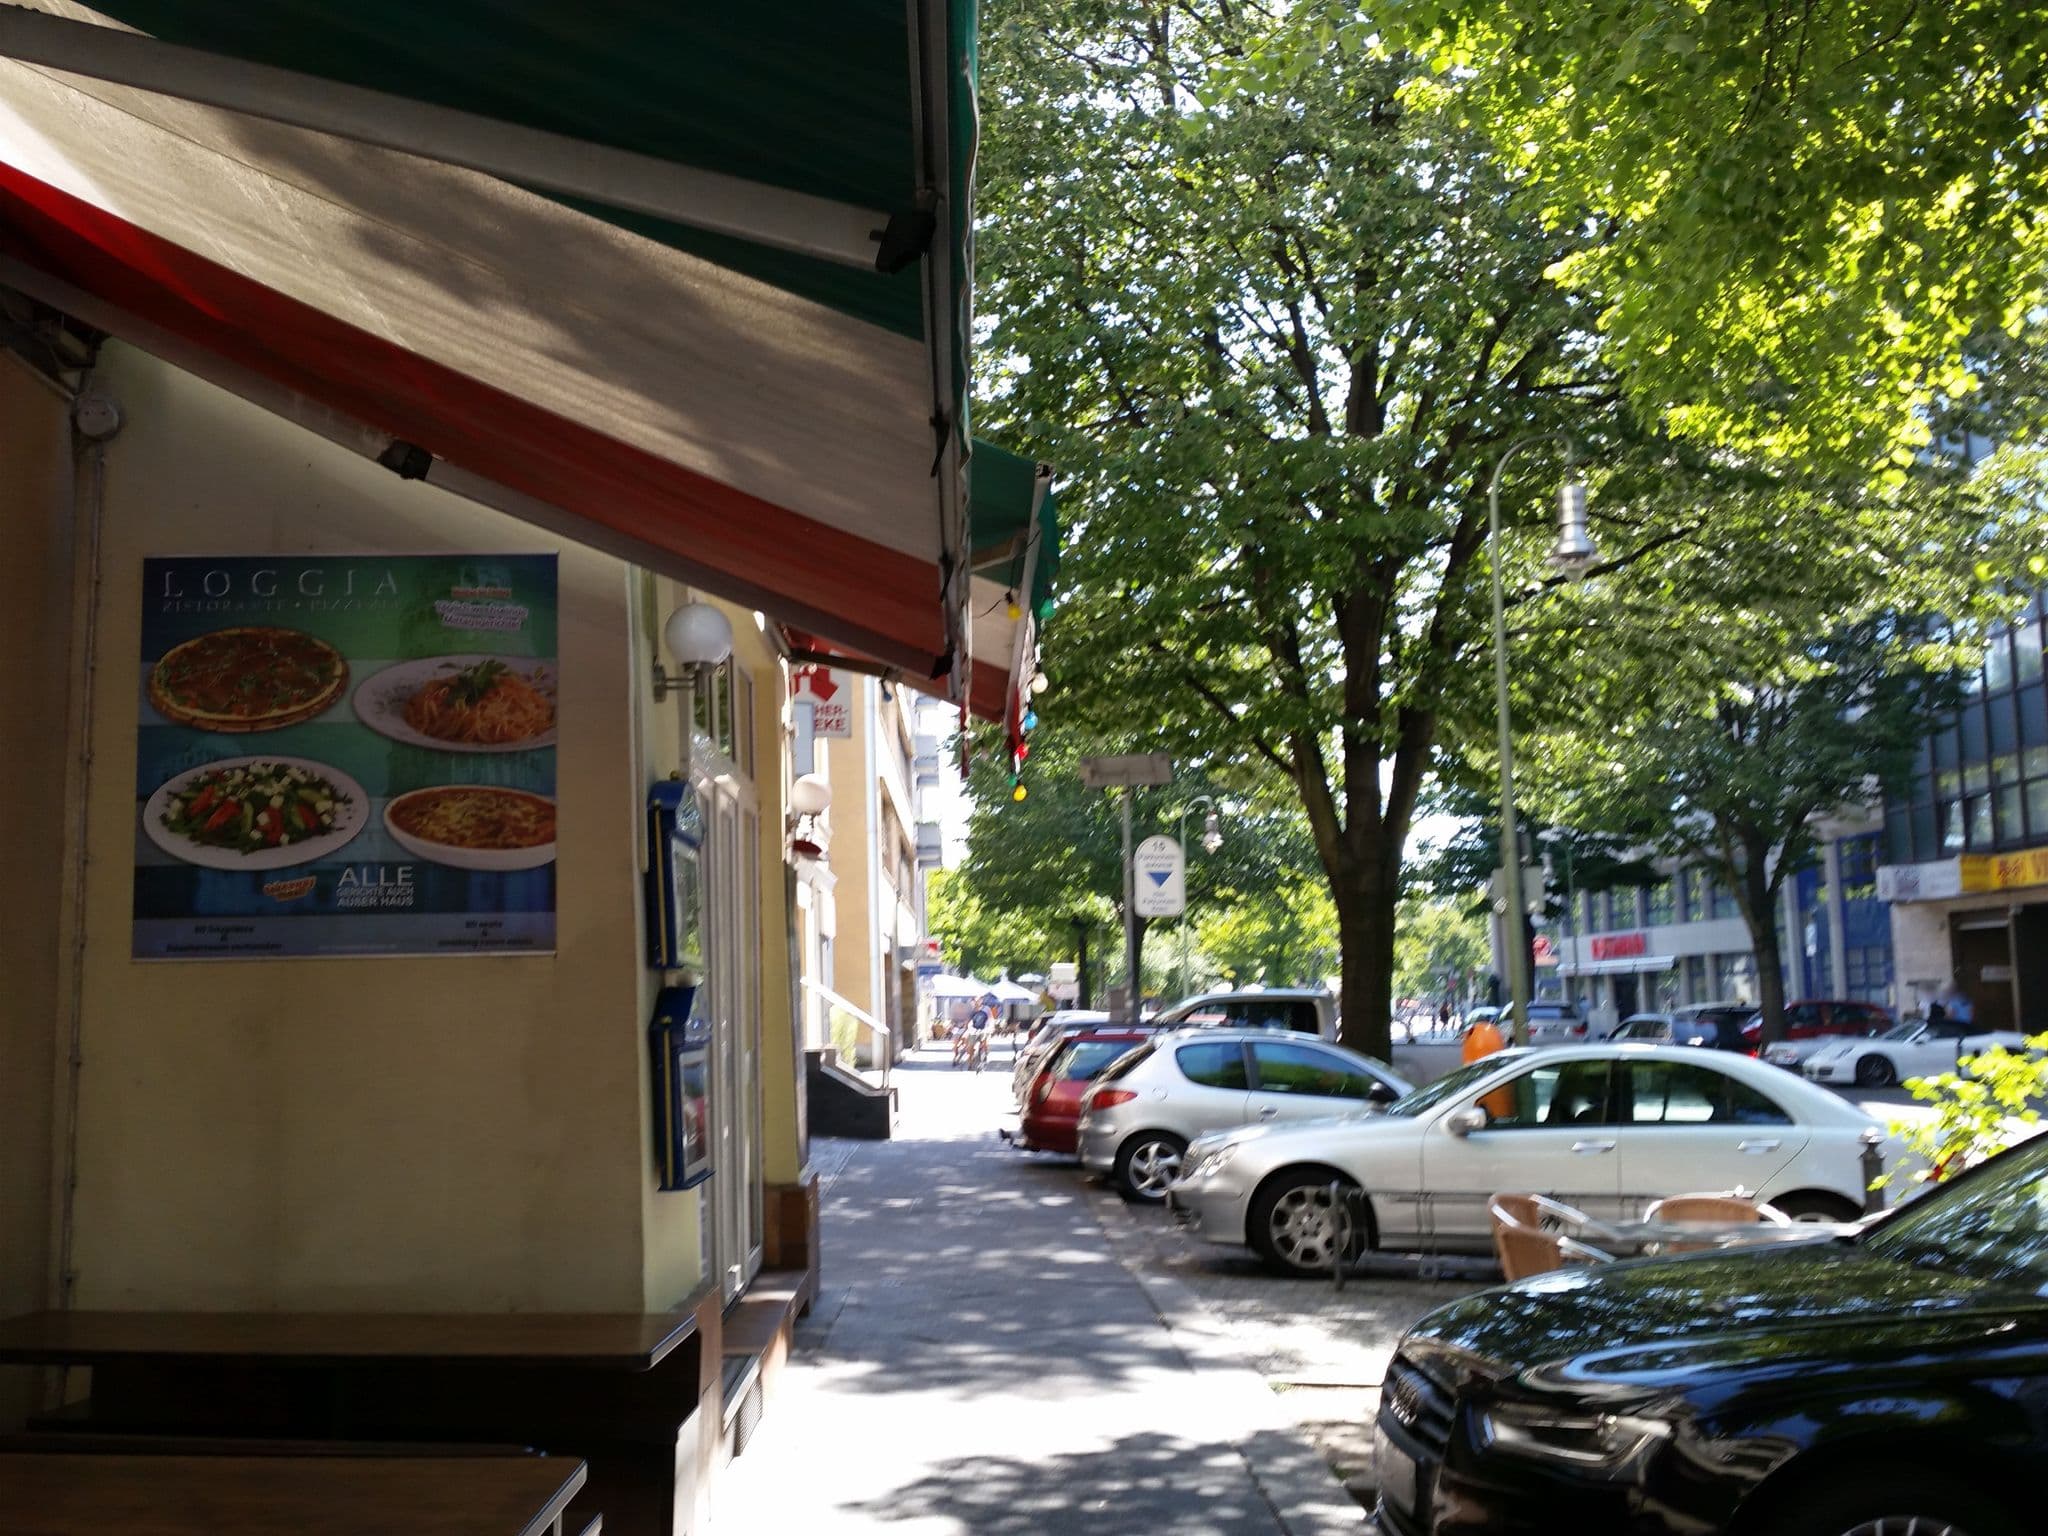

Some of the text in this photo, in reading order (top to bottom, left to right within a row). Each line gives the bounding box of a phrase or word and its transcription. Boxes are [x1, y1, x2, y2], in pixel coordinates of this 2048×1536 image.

[162, 569, 398, 597] LOGGIA
[337, 866, 414, 887] ALLE
[380, 895, 414, 907] HAUS
